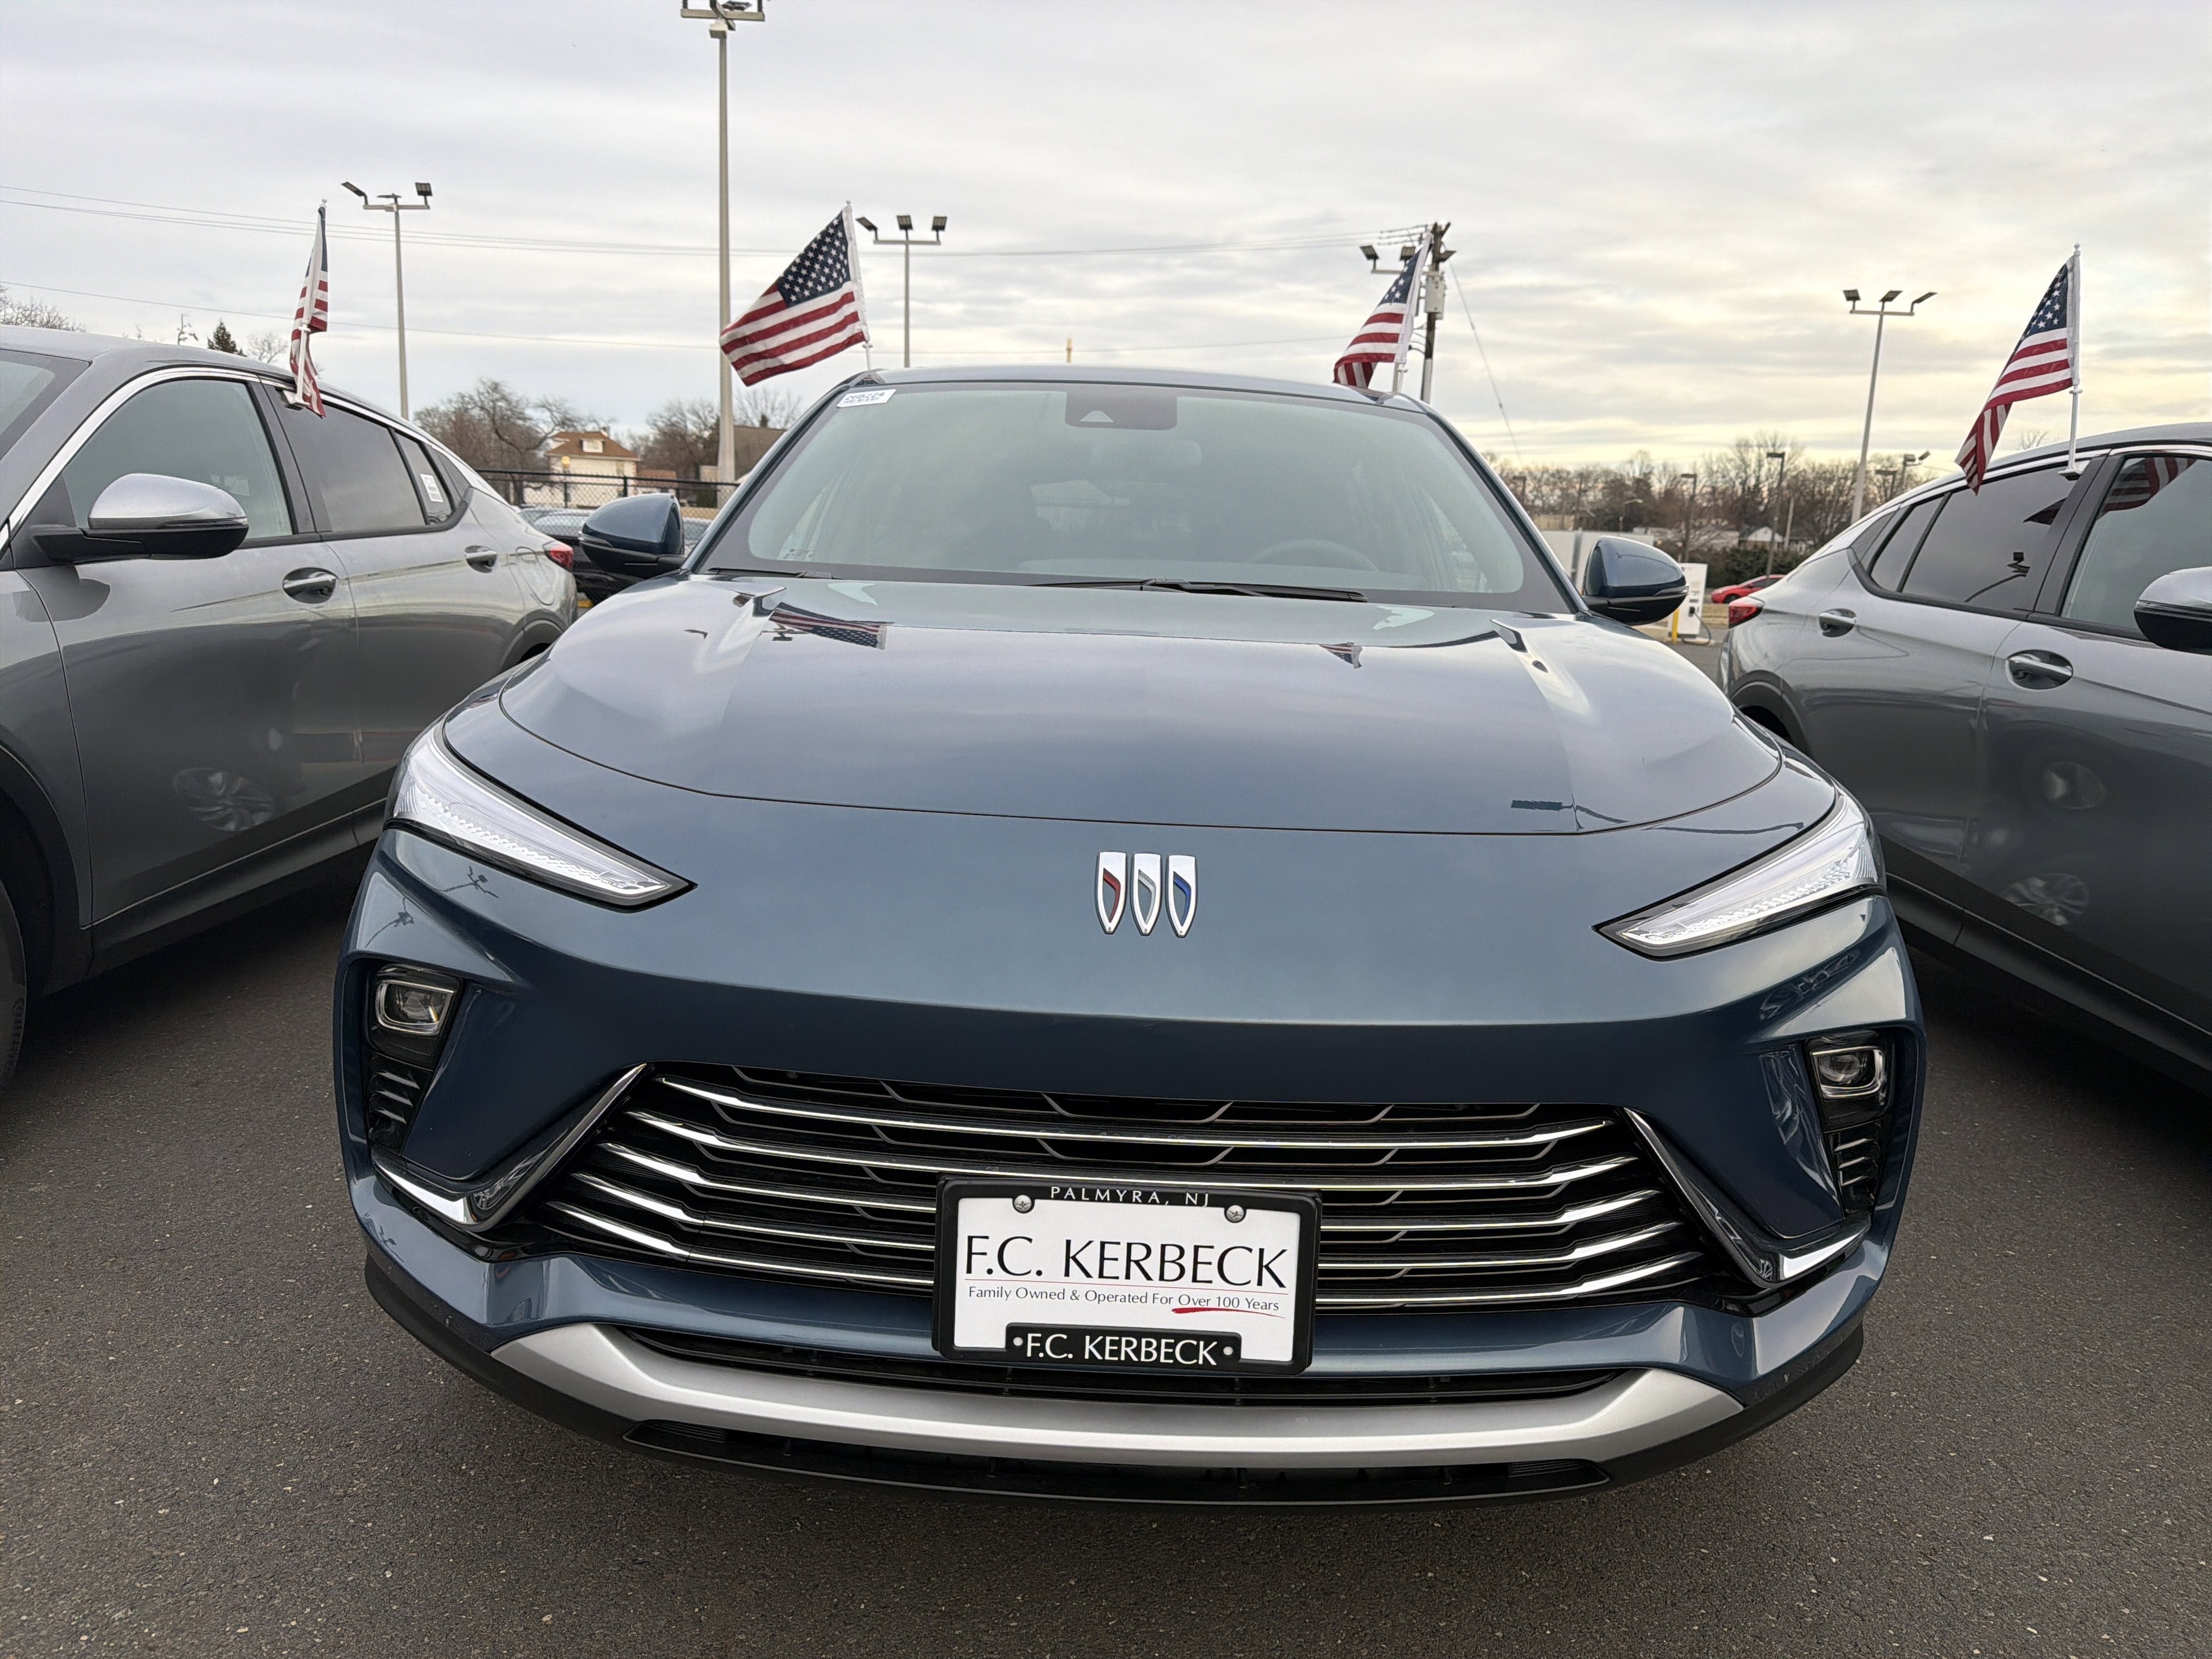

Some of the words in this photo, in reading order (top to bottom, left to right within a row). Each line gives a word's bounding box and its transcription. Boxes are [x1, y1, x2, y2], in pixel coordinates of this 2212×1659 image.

[1051, 1186, 1169, 1206] PALMYRA,
[1185, 1193, 1209, 1207] NJ
[966, 1235, 1043, 1277] F.C.
[1064, 1239, 1288, 1289] KERBECK
[969, 1286, 1012, 1301] Family
[1015, 1288, 1065, 1300] Owned
[1070, 1289, 1080, 1301] &
[1085, 1290, 1148, 1305] Operated
[1152, 1293, 1173, 1305] For
[1178, 1294, 1212, 1307] Over
[1216, 1296, 1240, 1308] 100
[1245, 1297, 1279, 1311] Years
[1026, 1333, 1074, 1360] F.C.
[1085, 1335, 1217, 1365] KERBECK
